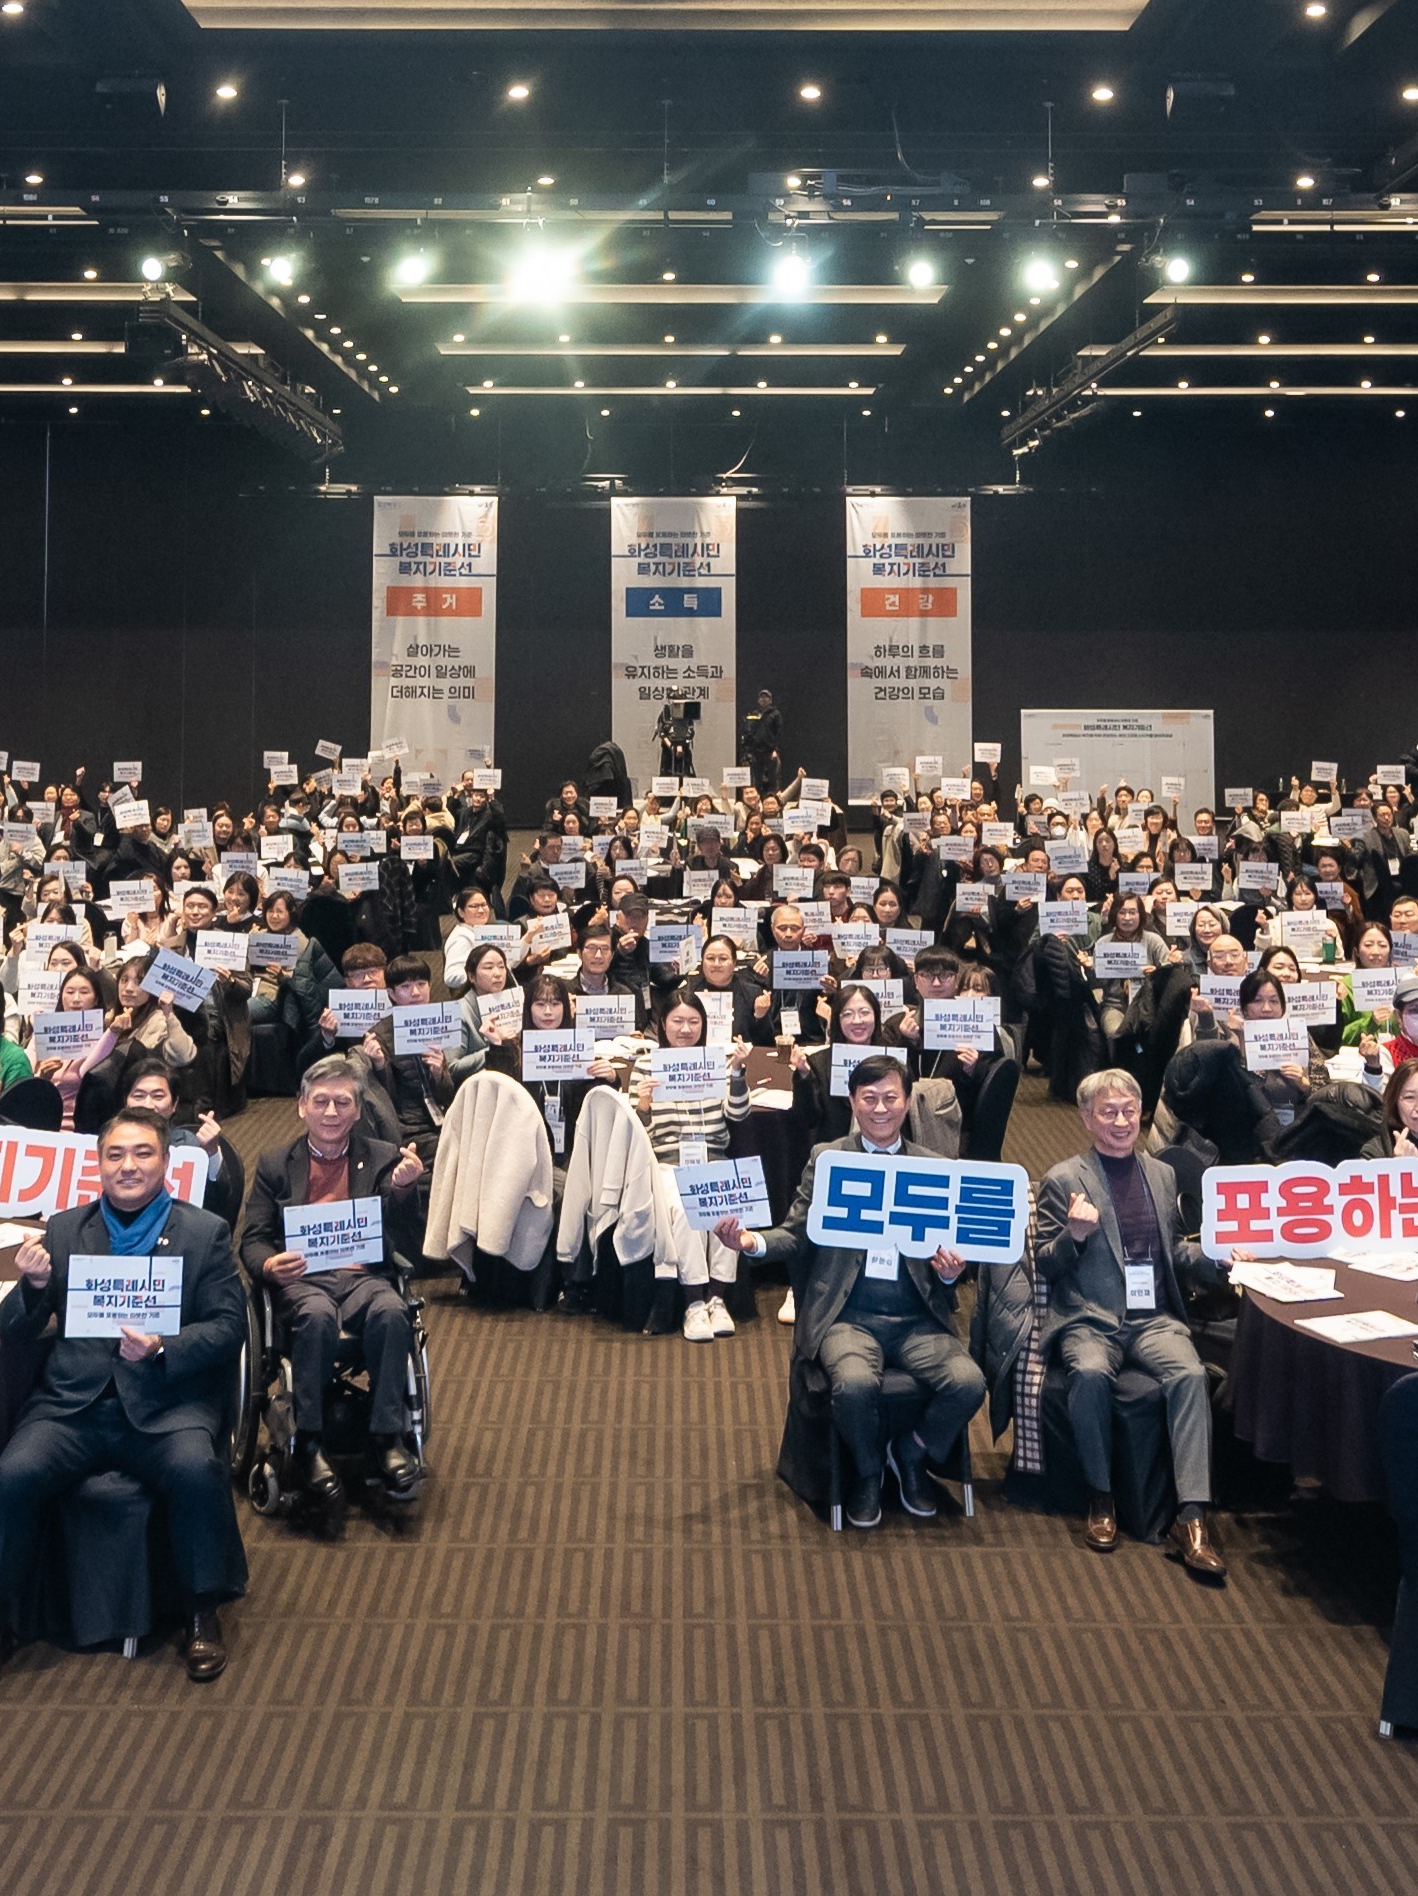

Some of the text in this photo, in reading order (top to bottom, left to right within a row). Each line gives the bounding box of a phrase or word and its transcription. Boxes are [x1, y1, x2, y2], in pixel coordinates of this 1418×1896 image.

[388, 543, 481, 558] 화성특례시민
[627, 543, 720, 558] 화성특례시민
[862, 543, 955, 558] 화성특례시민
[398, 561, 472, 577] 복지기준선
[637, 562, 711, 577] 복지기준선
[872, 562, 946, 577] 복지기준선
[406, 644, 460, 658] 살아가는
[653, 644, 694, 659] 생활을
[874, 644, 945, 659] 하루의 흐름
[391, 664, 476, 679] 공간이 일상에
[625, 665, 723, 680] 유지하는 소득과
[860, 665, 958, 680] 속에서 함께하는
[391, 686, 475, 700] 더해지는 의미
[874, 686, 945, 700] 건강의 모습
[663, 1061, 715, 1072] 화성특례시민
[689, 1177, 752, 1195] 화성특례시민
[698, 1192, 748, 1208] 복지기준선
[822, 1166, 1015, 1248] 모두를
[300, 1217, 367, 1236] 화성특례시민
[308, 1231, 361, 1248] 복지기준선
[85, 1279, 165, 1292] 화성특례시민
[93, 1295, 157, 1308] 복지기준선
